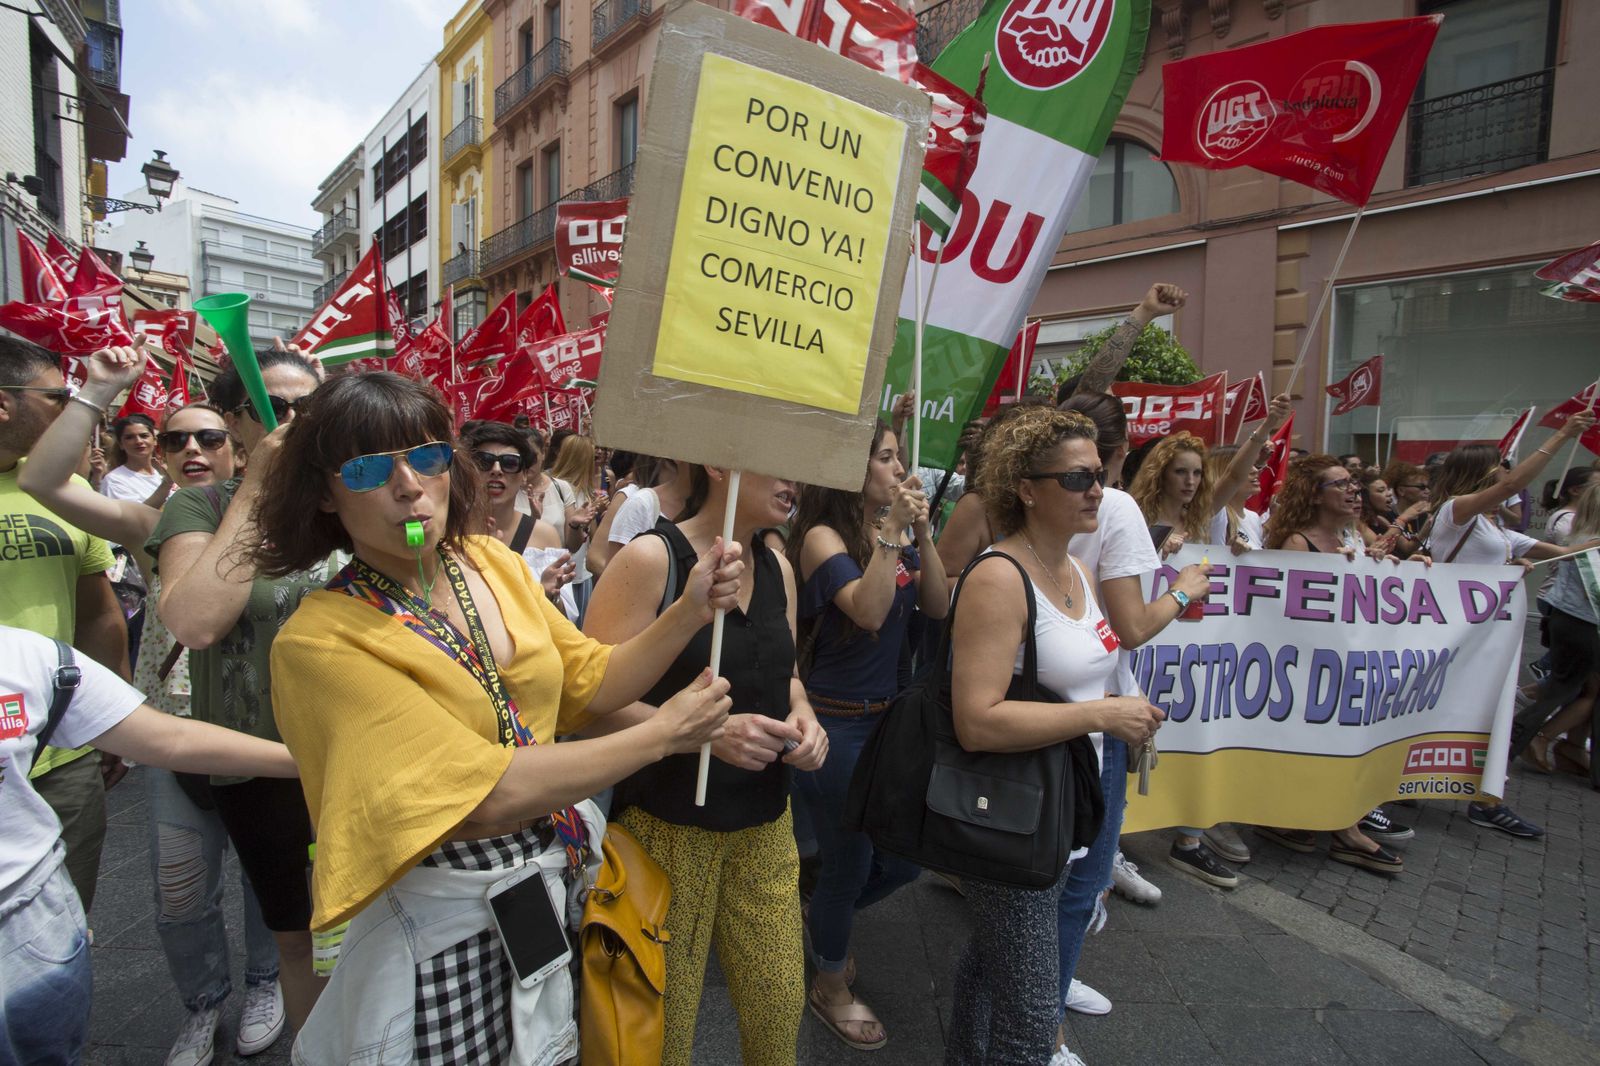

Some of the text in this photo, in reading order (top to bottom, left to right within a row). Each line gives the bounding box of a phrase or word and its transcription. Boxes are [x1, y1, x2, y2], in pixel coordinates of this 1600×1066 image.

[746, 97, 862, 159] POR UN
[1206, 91, 1267, 135] UGT
[712, 144, 874, 214] CONVENIO
[705, 195, 865, 264] DIGNO YA!
[700, 252, 854, 312] COMERCIO
[715, 306, 825, 354] SEVILLA
[1304, 646, 1459, 727] DERECHOS
[1398, 776, 1476, 795] servicios
[1407, 747, 1467, 768] CCOO
